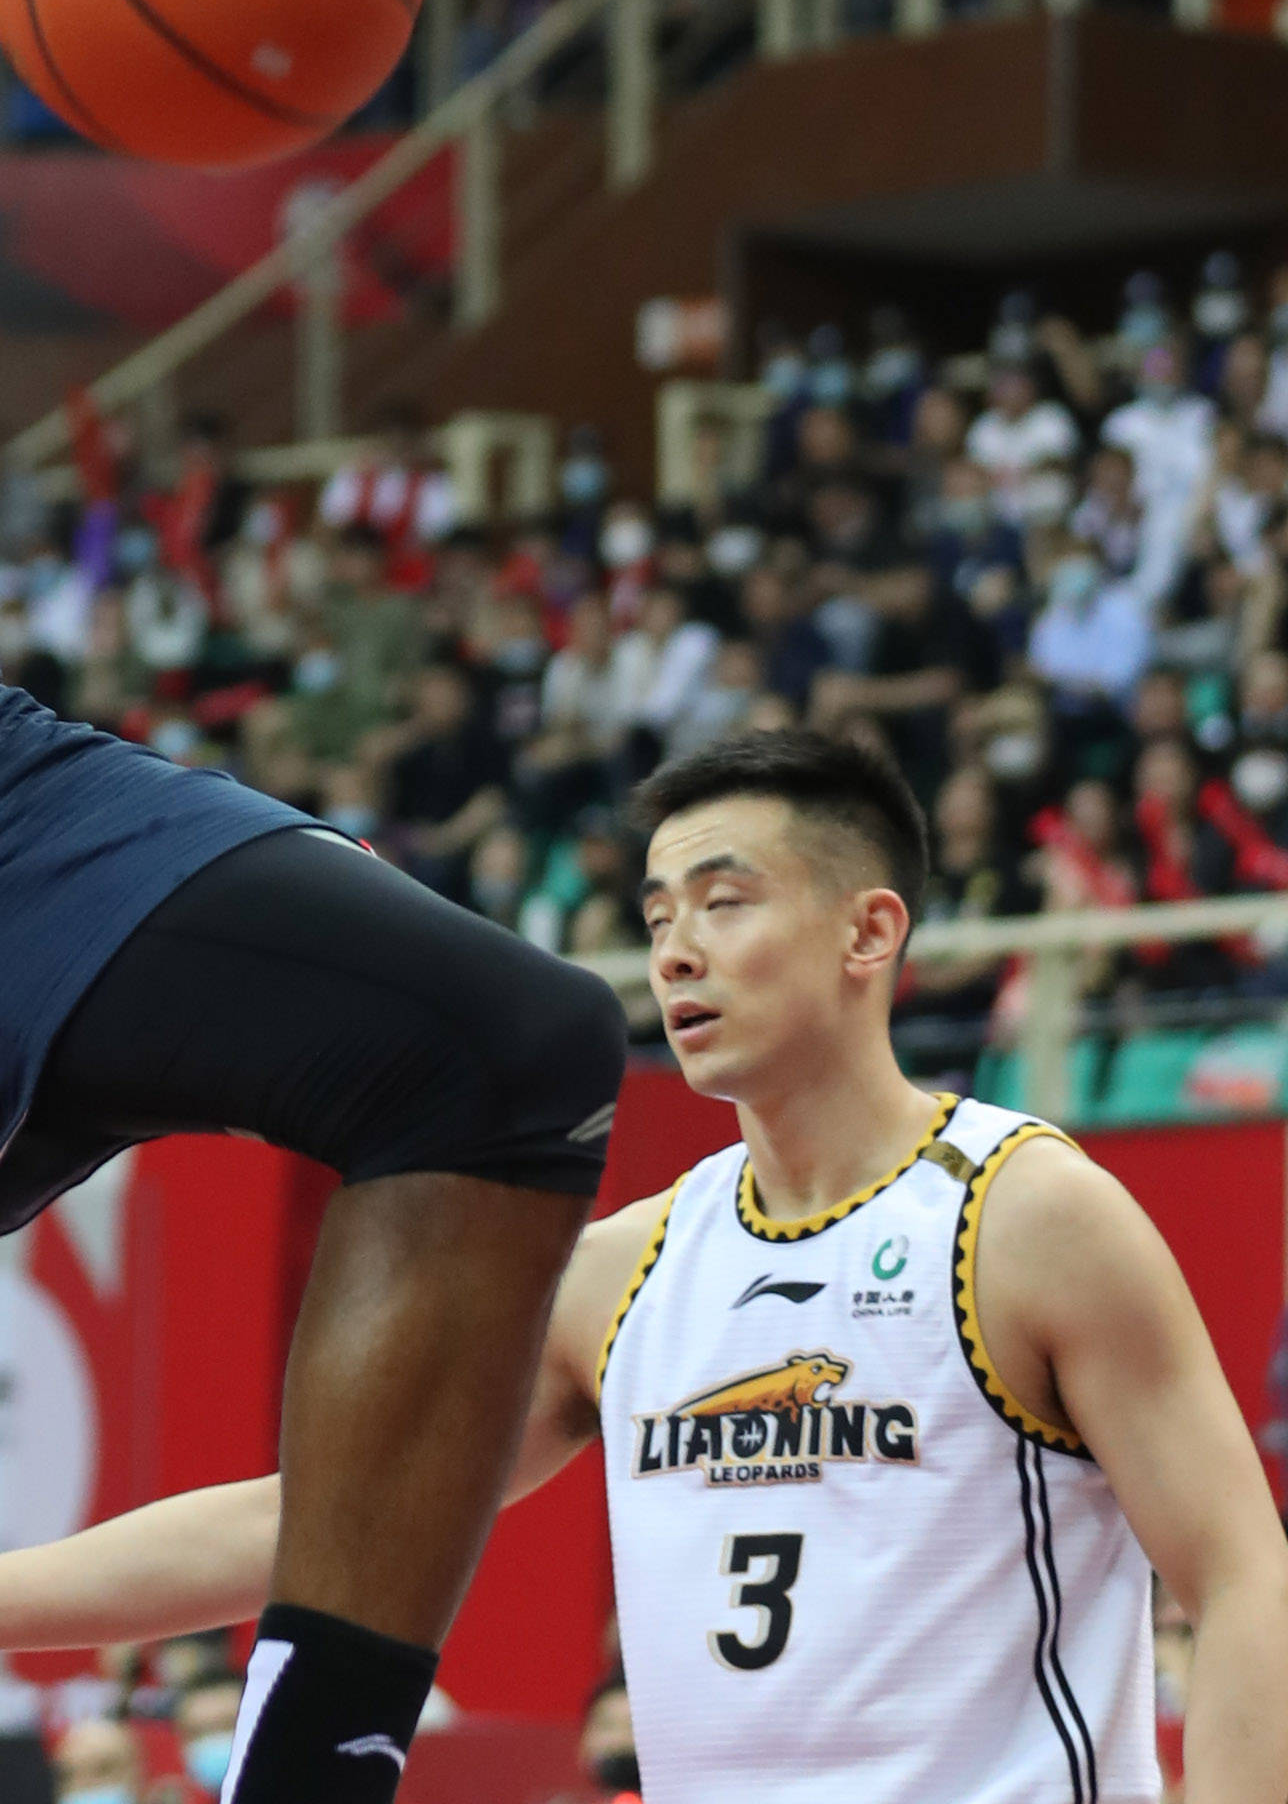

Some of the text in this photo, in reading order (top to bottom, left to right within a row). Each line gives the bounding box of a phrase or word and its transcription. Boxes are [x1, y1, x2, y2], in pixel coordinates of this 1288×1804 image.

[635, 1402, 918, 1474] LIAONING
[709, 1461, 821, 1484] LEOPARDS
[707, 1532, 806, 1672] 3
